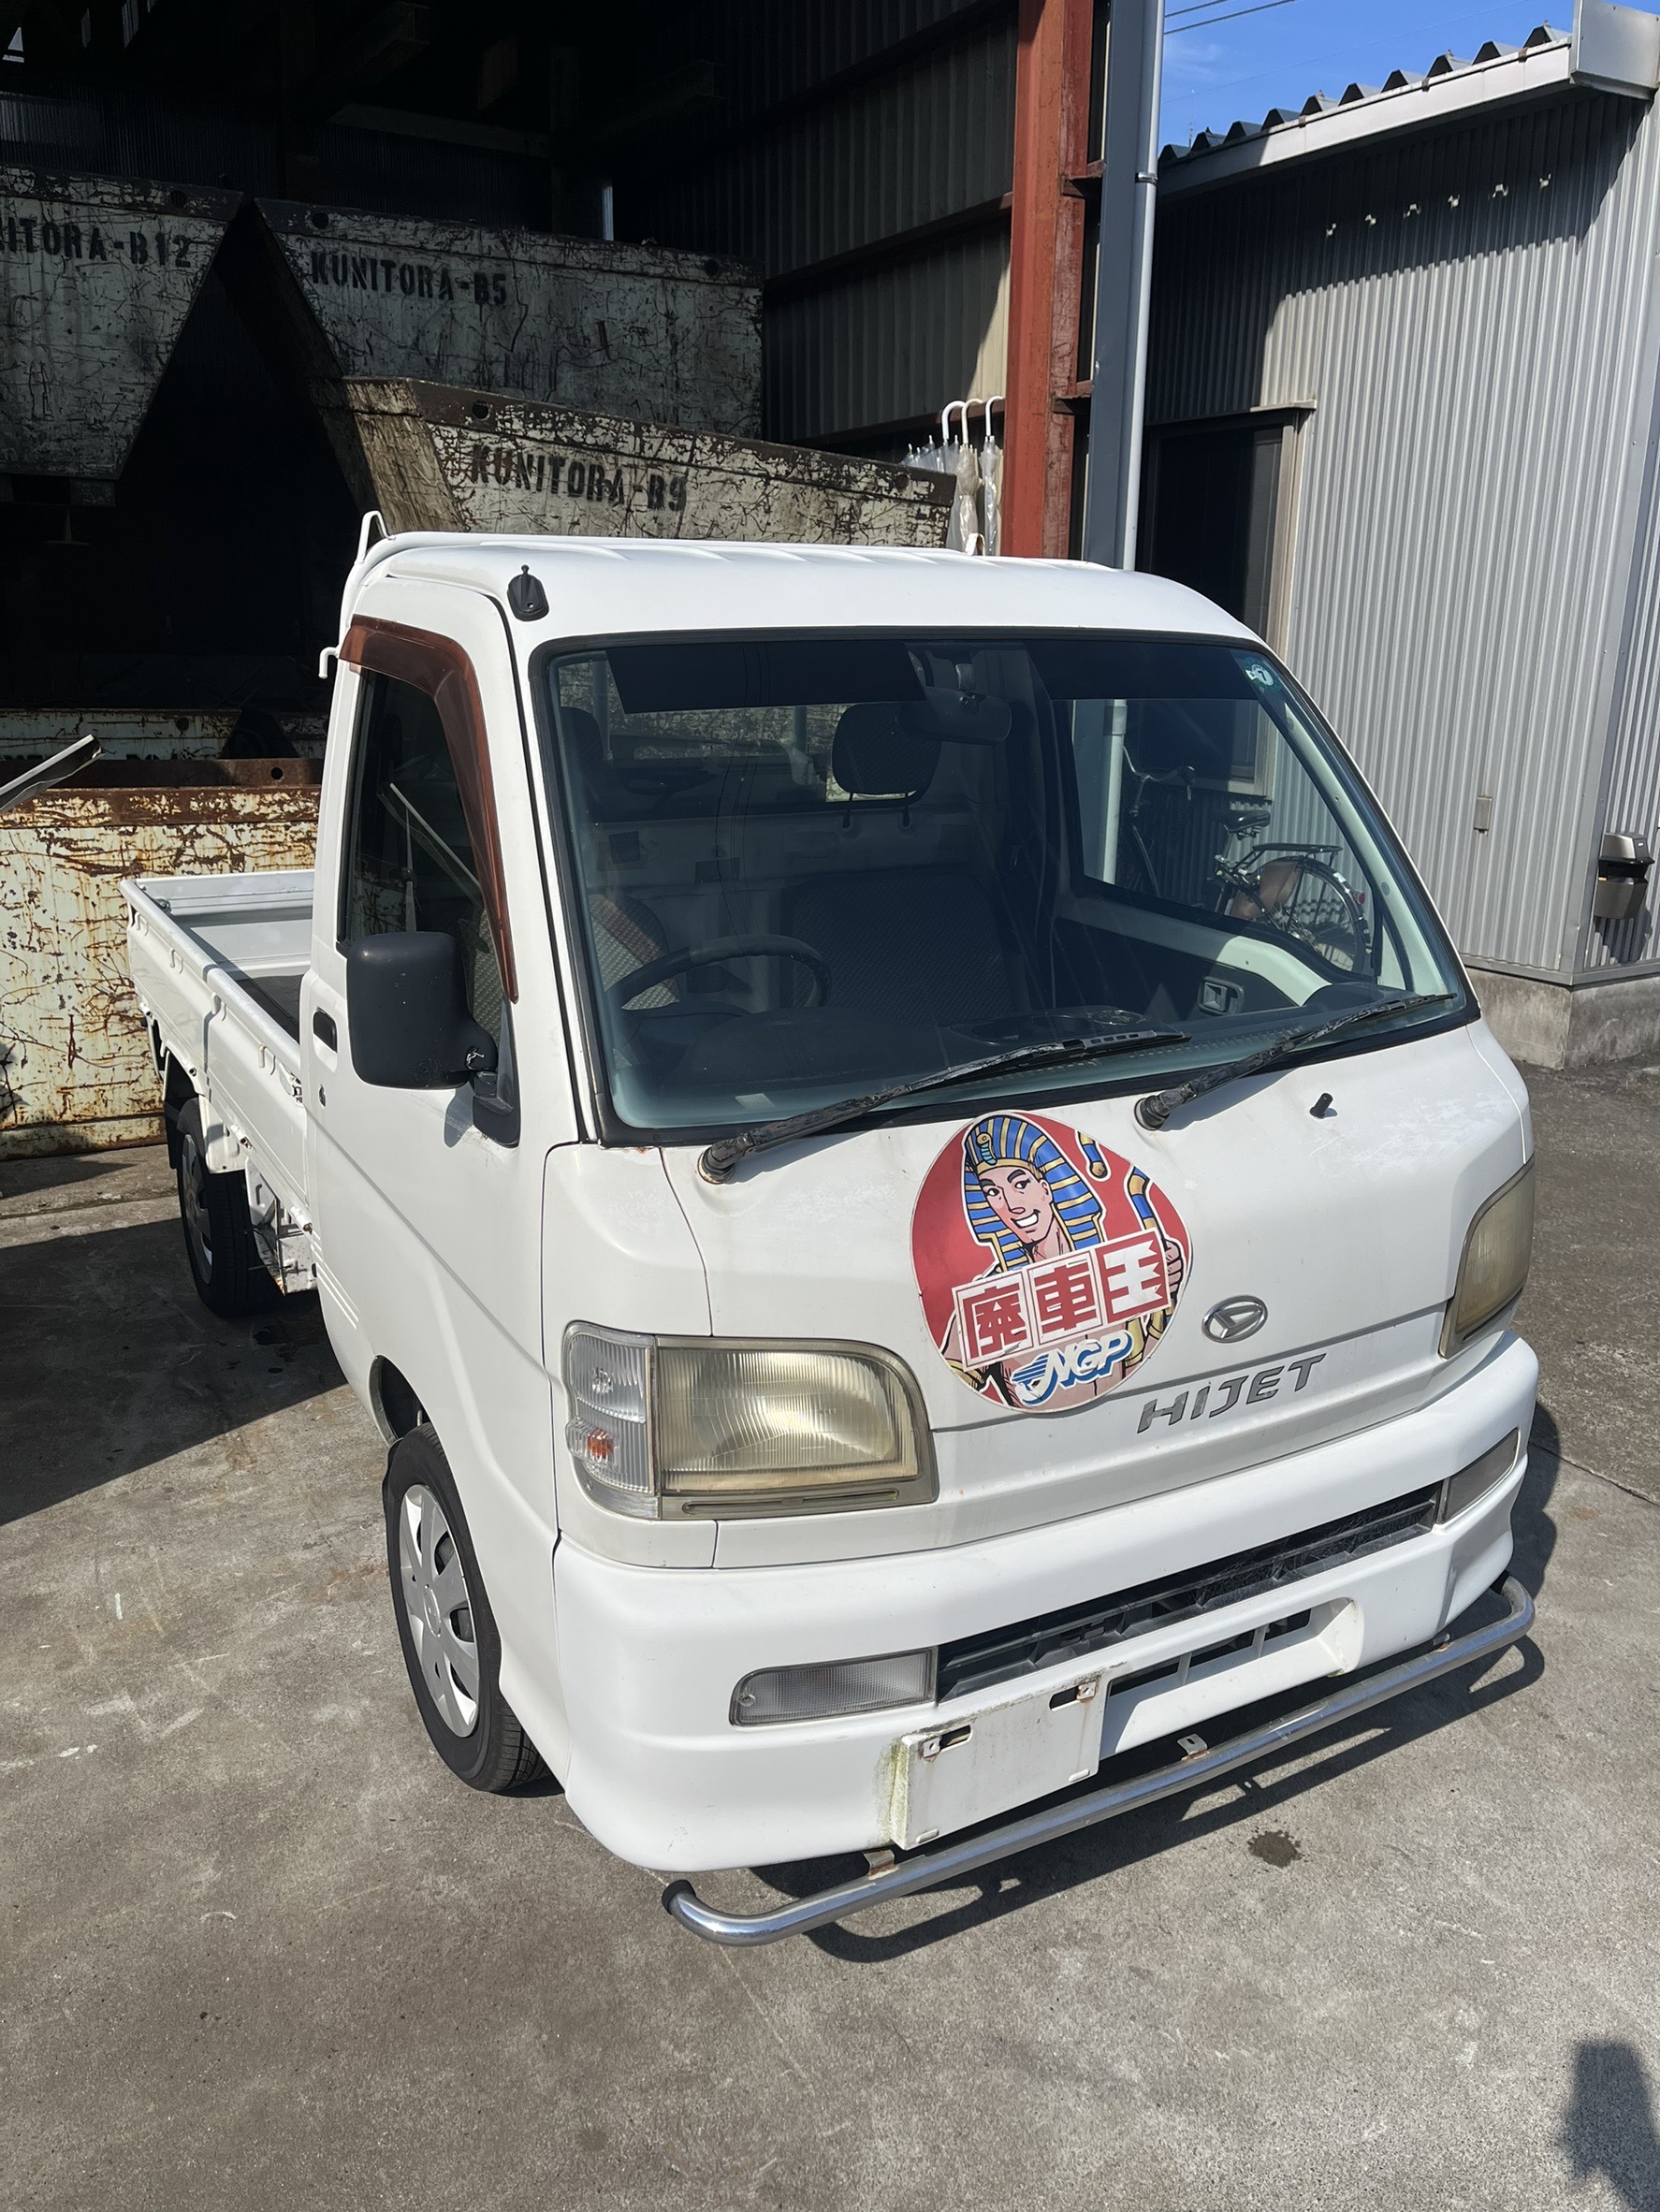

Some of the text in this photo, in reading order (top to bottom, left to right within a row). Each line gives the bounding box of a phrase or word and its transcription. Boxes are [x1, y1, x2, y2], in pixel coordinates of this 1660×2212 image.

[0, 217, 192, 268] ITORA-B12
[311, 251, 507, 306] KUNITORA-B5
[470, 443, 689, 513] KUNITORA-B9
[961, 1237, 1166, 1361] 廃車王
[1012, 1329, 1134, 1405] NGP
[1137, 1353, 1327, 1434] HIJET
